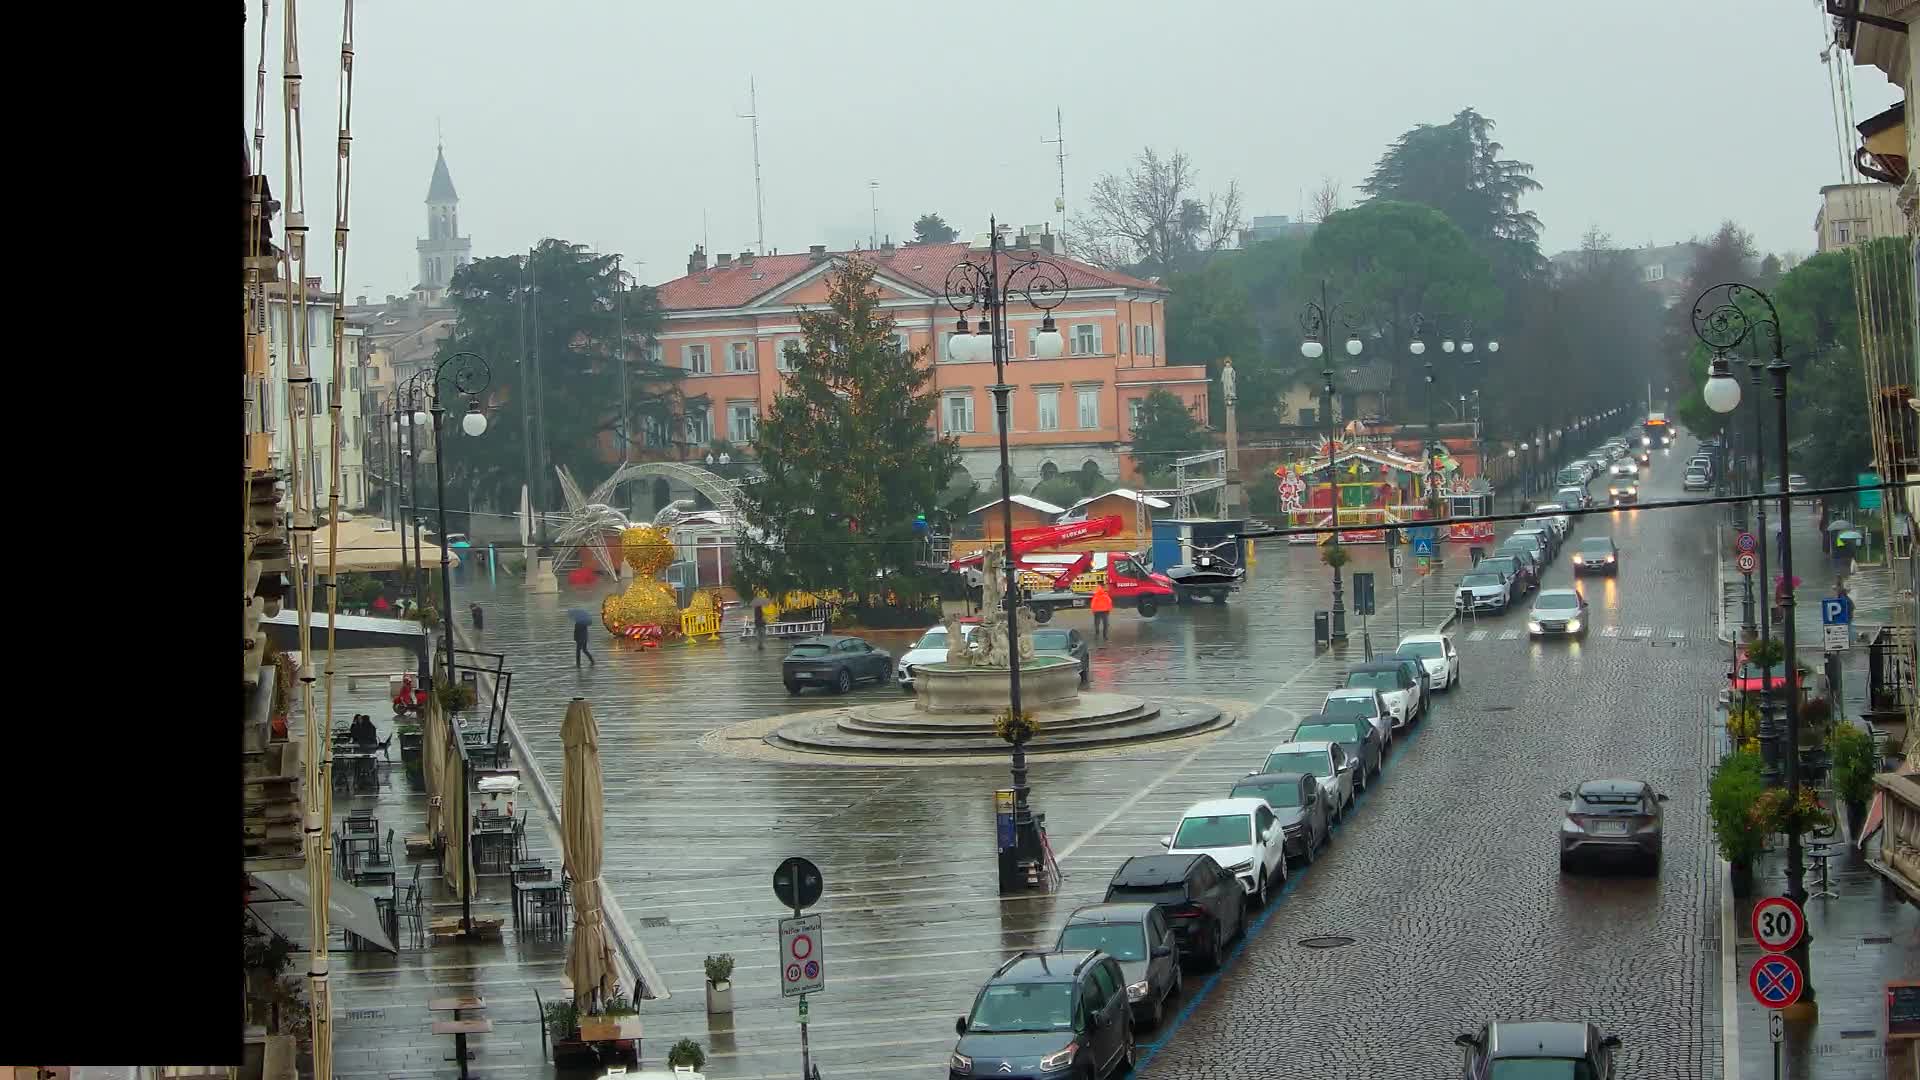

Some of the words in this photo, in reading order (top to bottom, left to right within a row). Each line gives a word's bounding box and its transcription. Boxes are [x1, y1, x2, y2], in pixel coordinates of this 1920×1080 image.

[1742, 557, 1752, 567] 20
[1827, 602, 1842, 621] P
[1762, 911, 1792, 937] 30
